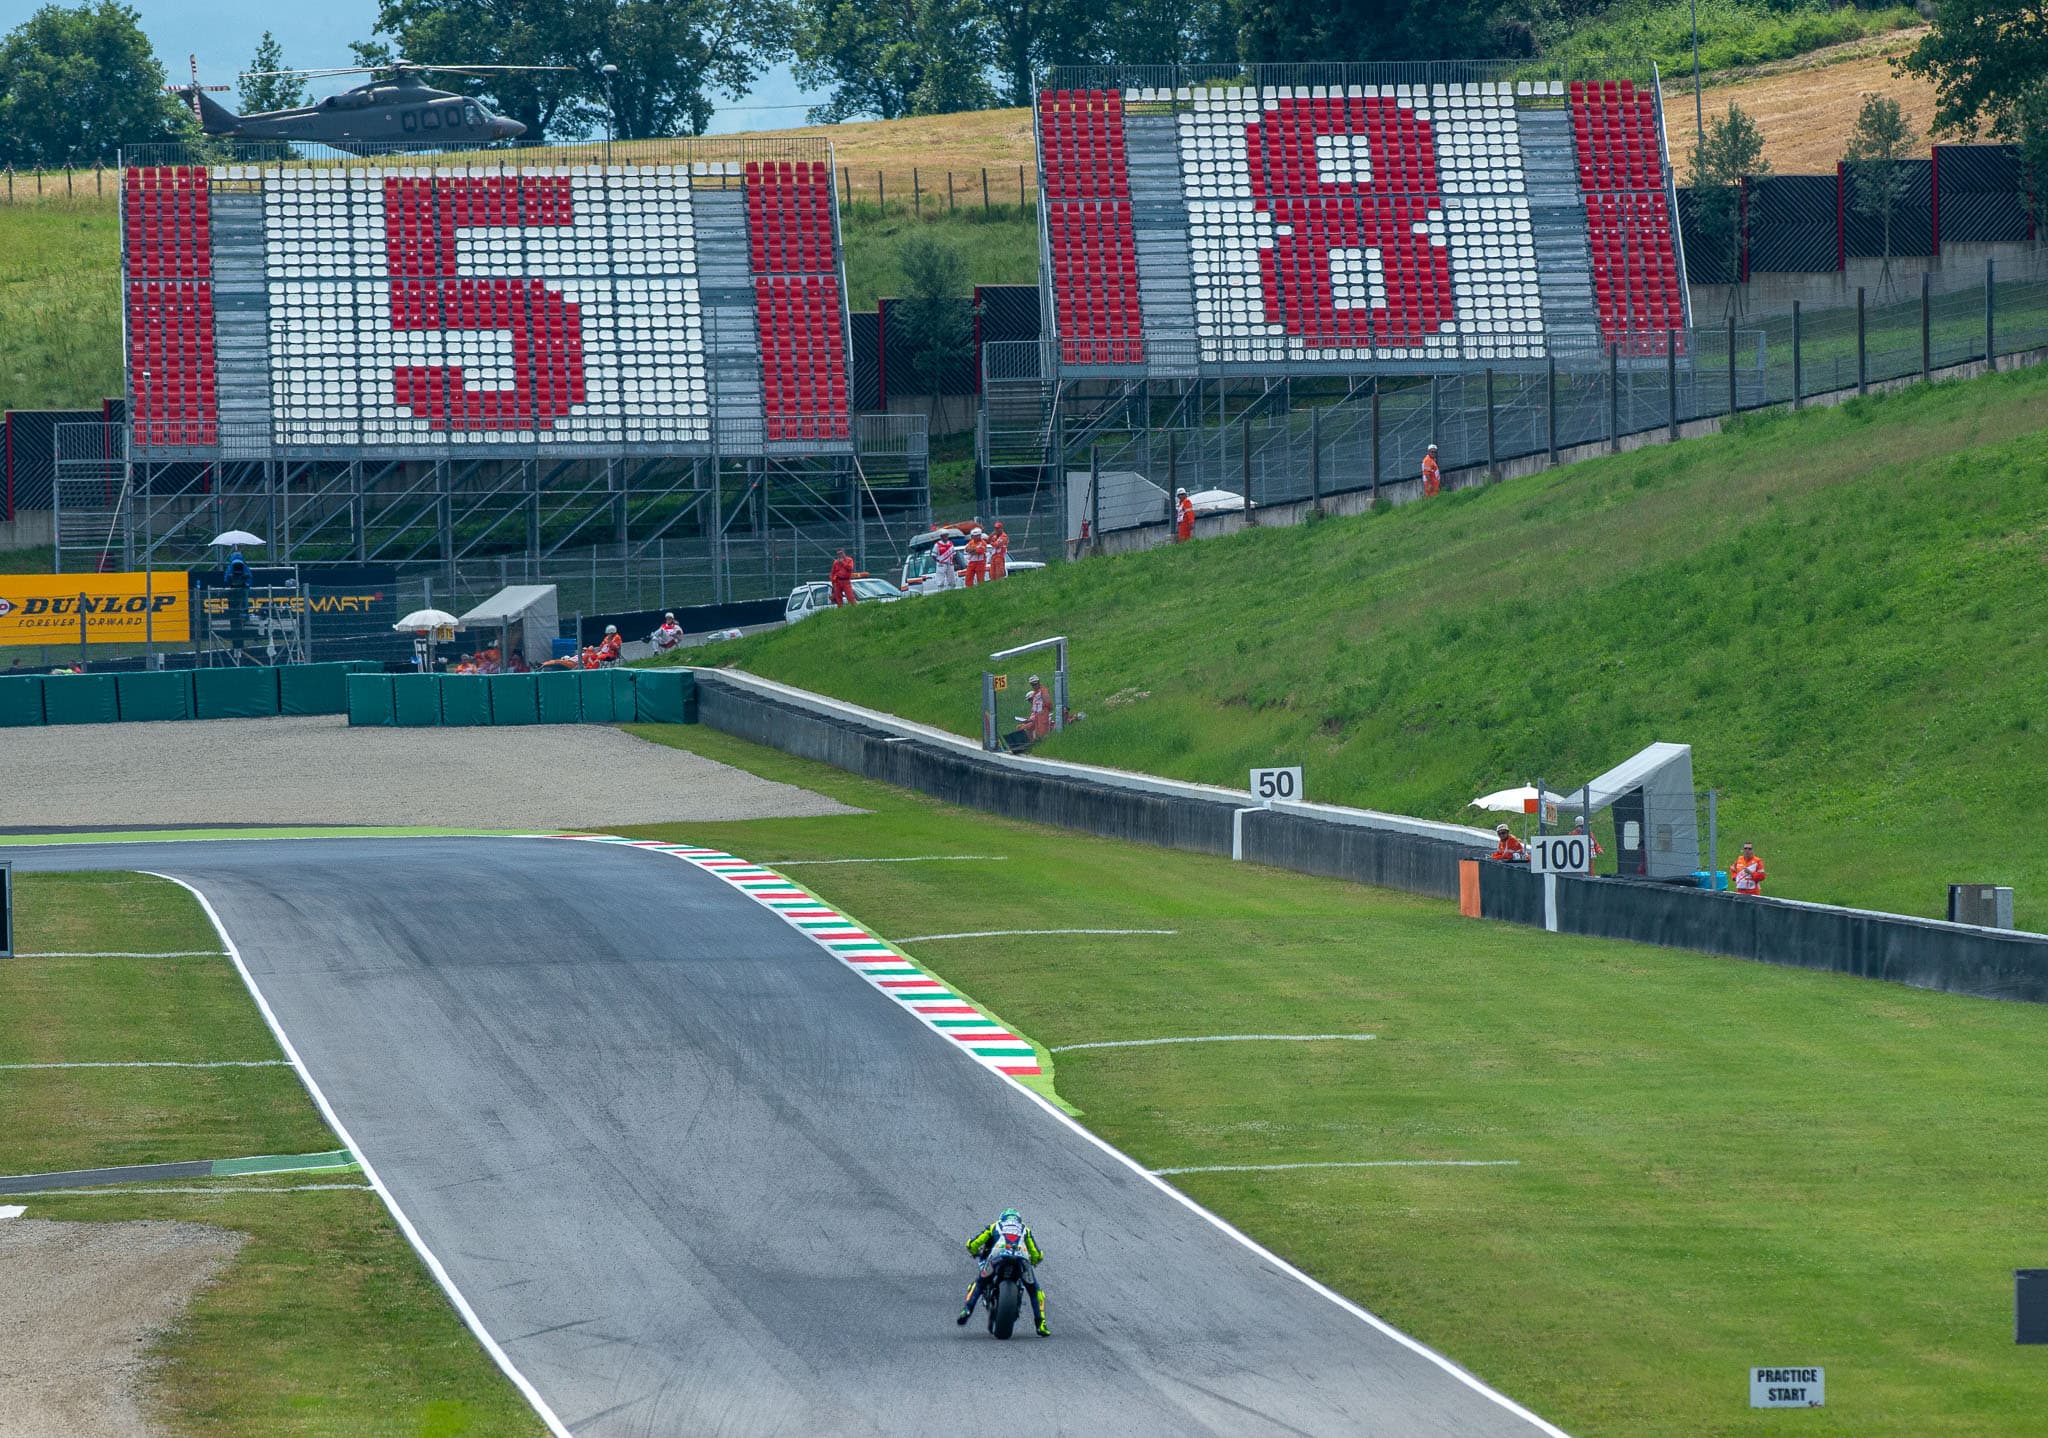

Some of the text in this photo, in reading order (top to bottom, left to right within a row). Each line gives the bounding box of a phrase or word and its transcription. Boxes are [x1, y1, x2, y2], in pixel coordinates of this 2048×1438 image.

[21, 596, 177, 616] DUNLOP
[18, 617, 143, 628] FOREVER ORWARD
[1259, 771, 1294, 798] 50
[1536, 839, 1585, 870] 100
[1757, 1369, 1818, 1383] PRACTICE
[1768, 1388, 1807, 1402] START
